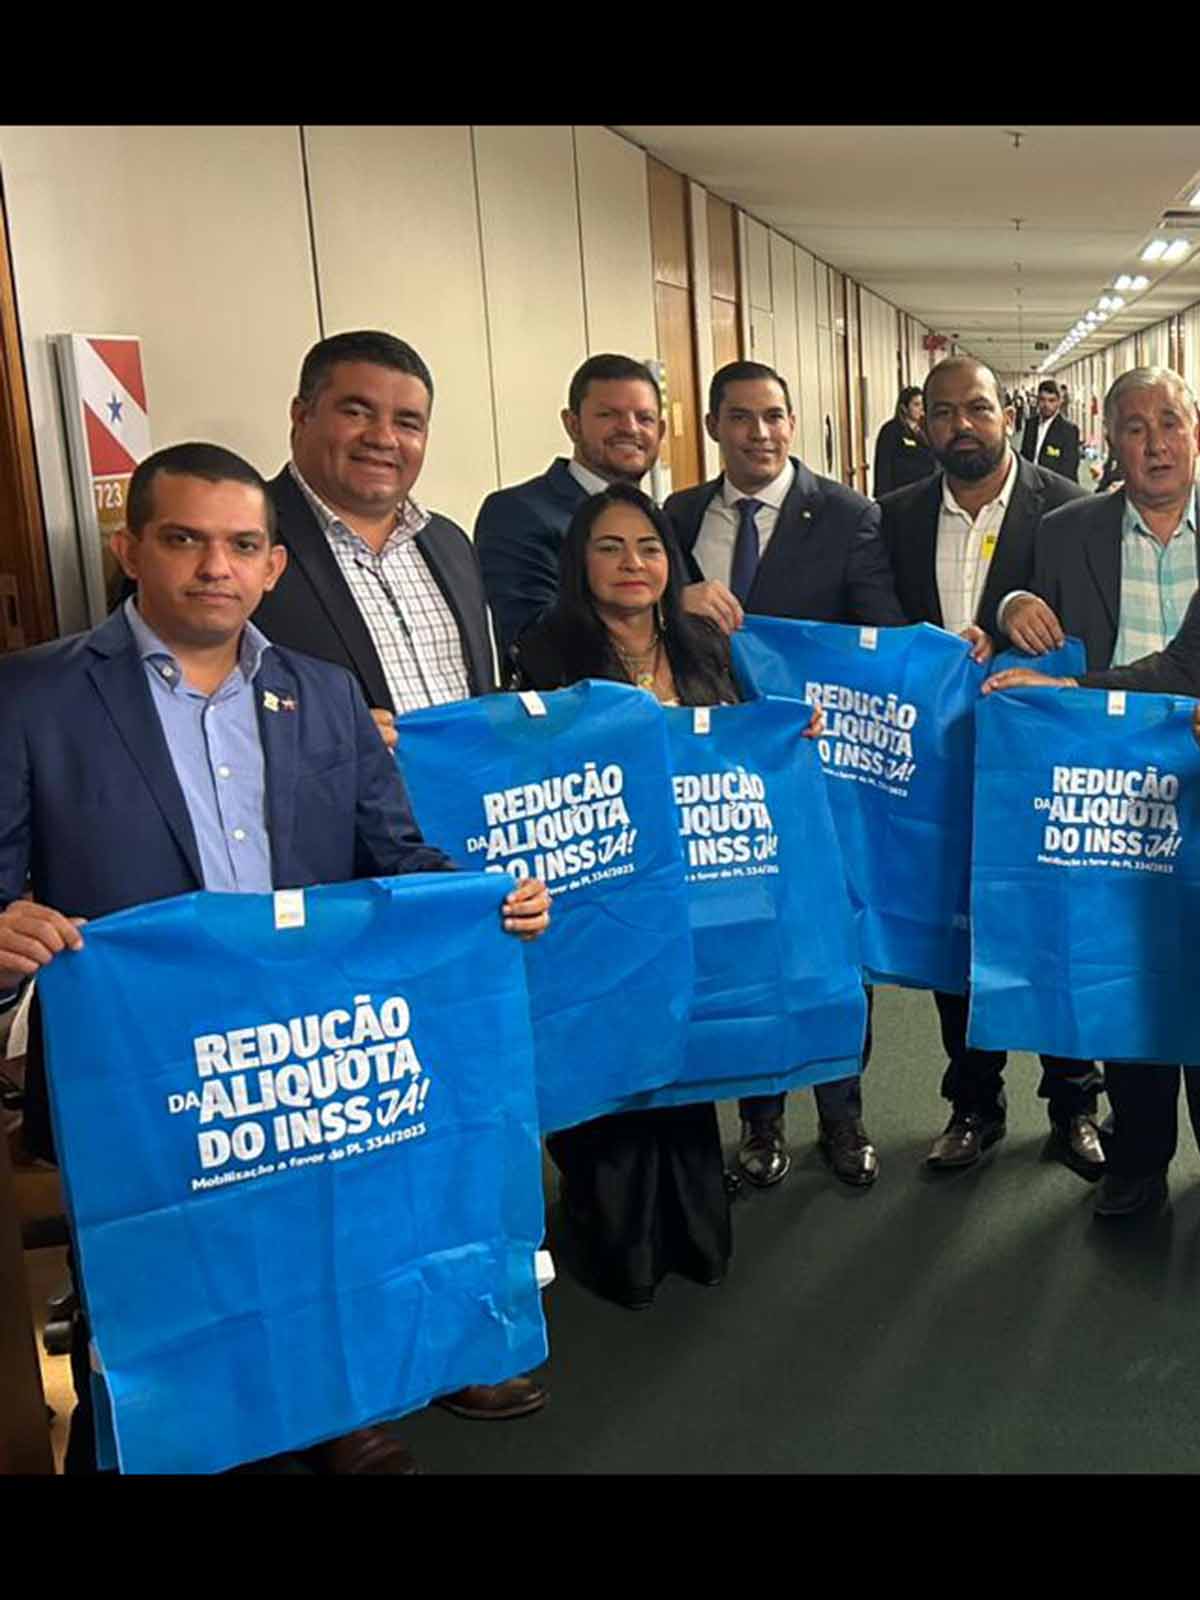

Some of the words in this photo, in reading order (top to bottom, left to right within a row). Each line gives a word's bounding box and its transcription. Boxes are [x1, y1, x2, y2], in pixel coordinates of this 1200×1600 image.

[95, 481, 123, 509] 723
[805, 681, 917, 730] REDUÇÃO
[820, 709, 912, 758] LIQUOTA
[671, 764, 766, 805] EDUÇÃO
[818, 739, 831, 763] O
[835, 741, 884, 775] INSS
[885, 756, 916, 782] JÁ!
[1053, 765, 1179, 801] REDUÇÃO
[483, 761, 623, 826] REDUÇÃO
[1034, 797, 1051, 810] DA
[1048, 796, 1179, 830] ALIQUOTA
[466, 835, 488, 853] DA
[486, 797, 631, 860] ALIQUOTA
[678, 801, 773, 837] IQUOTA
[1044, 825, 1080, 853] DO
[1084, 828, 1143, 856] INSS
[1144, 831, 1183, 858] JÁ!
[534, 839, 597, 881] INSS
[597, 824, 638, 864] JÁ!
[688, 834, 751, 867] INSS
[194, 994, 411, 1077] REDUÇÃO
[168, 1090, 201, 1114] DA
[198, 1039, 422, 1124] ALIQUOTA
[197, 1121, 265, 1169] DO
[273, 1096, 372, 1152] INSS
[376, 1075, 430, 1126] JÁ!
[191, 1164, 275, 1190] Mobilização
[278, 1161, 287, 1170] a
[289, 1153, 325, 1167] favor
[346, 1142, 364, 1156] PL
[366, 1122, 426, 1151] 334/2023
